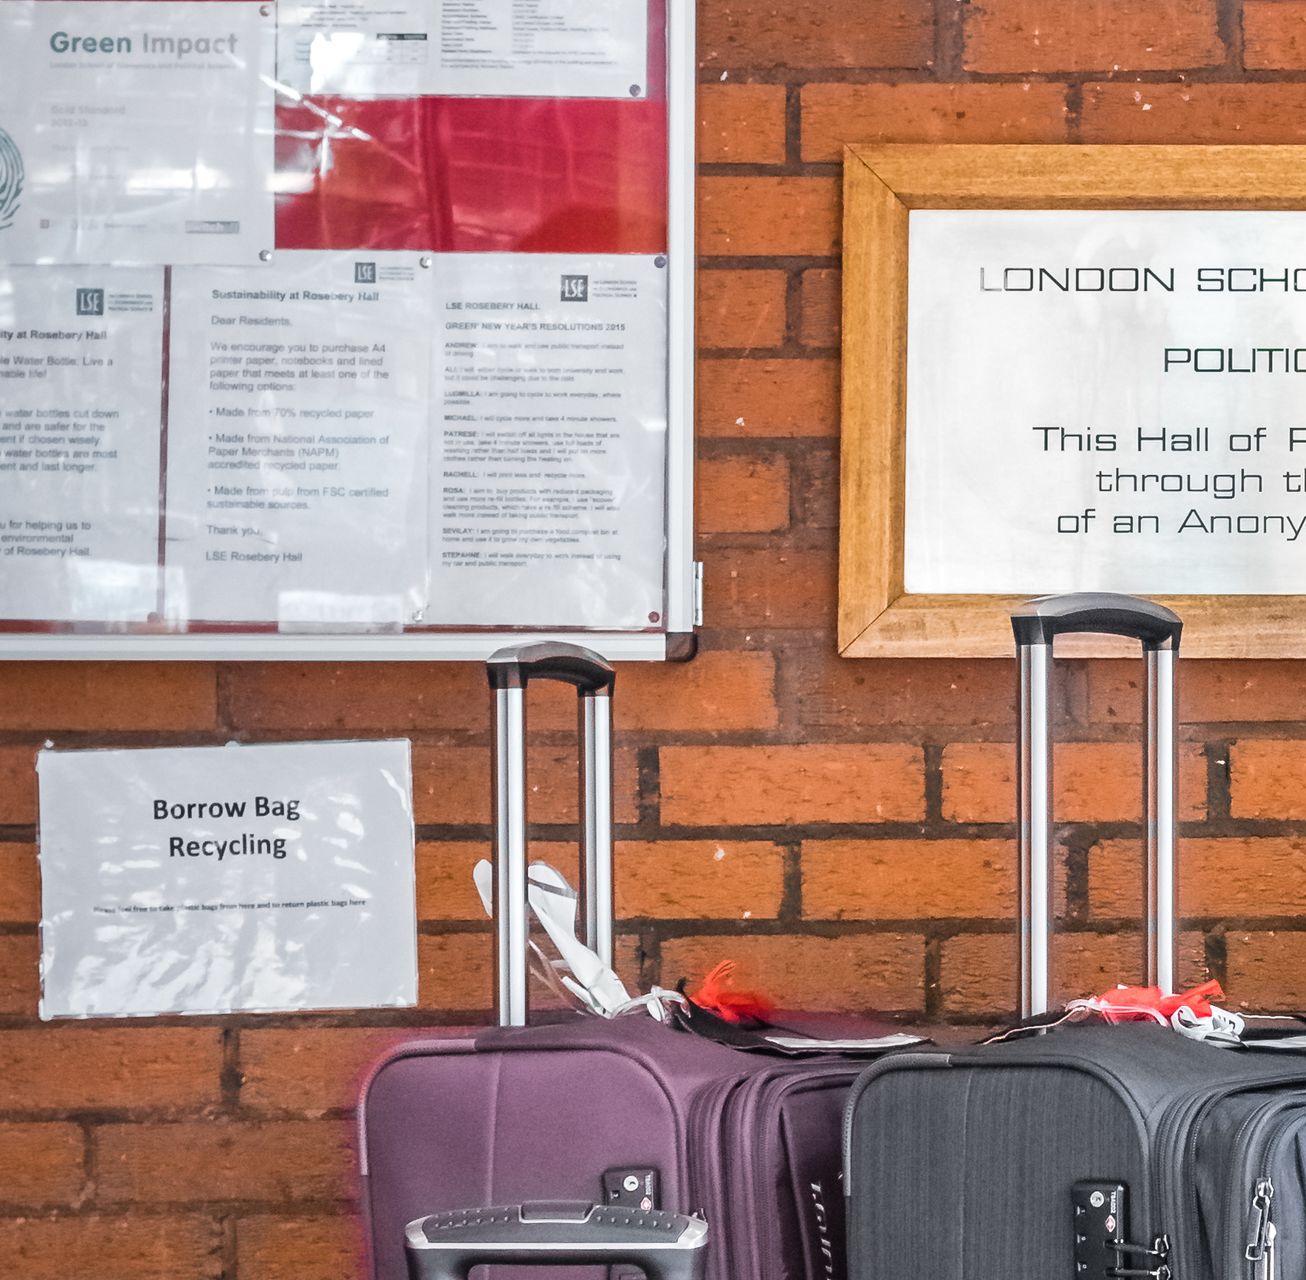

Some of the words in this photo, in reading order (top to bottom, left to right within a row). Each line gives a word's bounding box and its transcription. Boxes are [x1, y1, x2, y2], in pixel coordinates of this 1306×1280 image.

[50, 31, 132, 54] Green
[143, 32, 239, 59] Impact
[355, 263, 376, 283] LSE
[981, 268, 1174, 291] LONDON
[212, 289, 286, 302] Sustainability
[289, 291, 299, 300] at
[358, 291, 380, 302] Hall
[562, 277, 586, 300] LSE
[78, 290, 103, 314] LSE
[445, 302, 463, 310] LSE
[465, 302, 514, 310] ROSEBERY
[16, 330, 27, 340] at
[30, 330, 82, 342] Rosebery
[85, 331, 107, 340] Hall
[482, 323, 501, 331] NEW
[605, 323, 626, 331] 2015
[5, 410, 33, 418] water
[36, 409, 70, 418] bottles
[73, 410, 89, 419] cut
[92, 409, 119, 419] down
[1033, 427, 1116, 451] This
[1138, 427, 1208, 451] Hall
[1230, 428, 1266, 451] of
[1096, 468, 1262, 499] through
[1058, 509, 1095, 533] of
[1114, 516, 1158, 533] an
[2, 533, 74, 543] environmental
[17, 546, 66, 558] Rosebery
[205, 551, 227, 561] LSE
[230, 551, 280, 563] Rosebery
[283, 552, 303, 562] Hall
[153, 799, 247, 820] Borrow
[254, 796, 301, 821] Bag
[168, 833, 287, 860] Recycling
